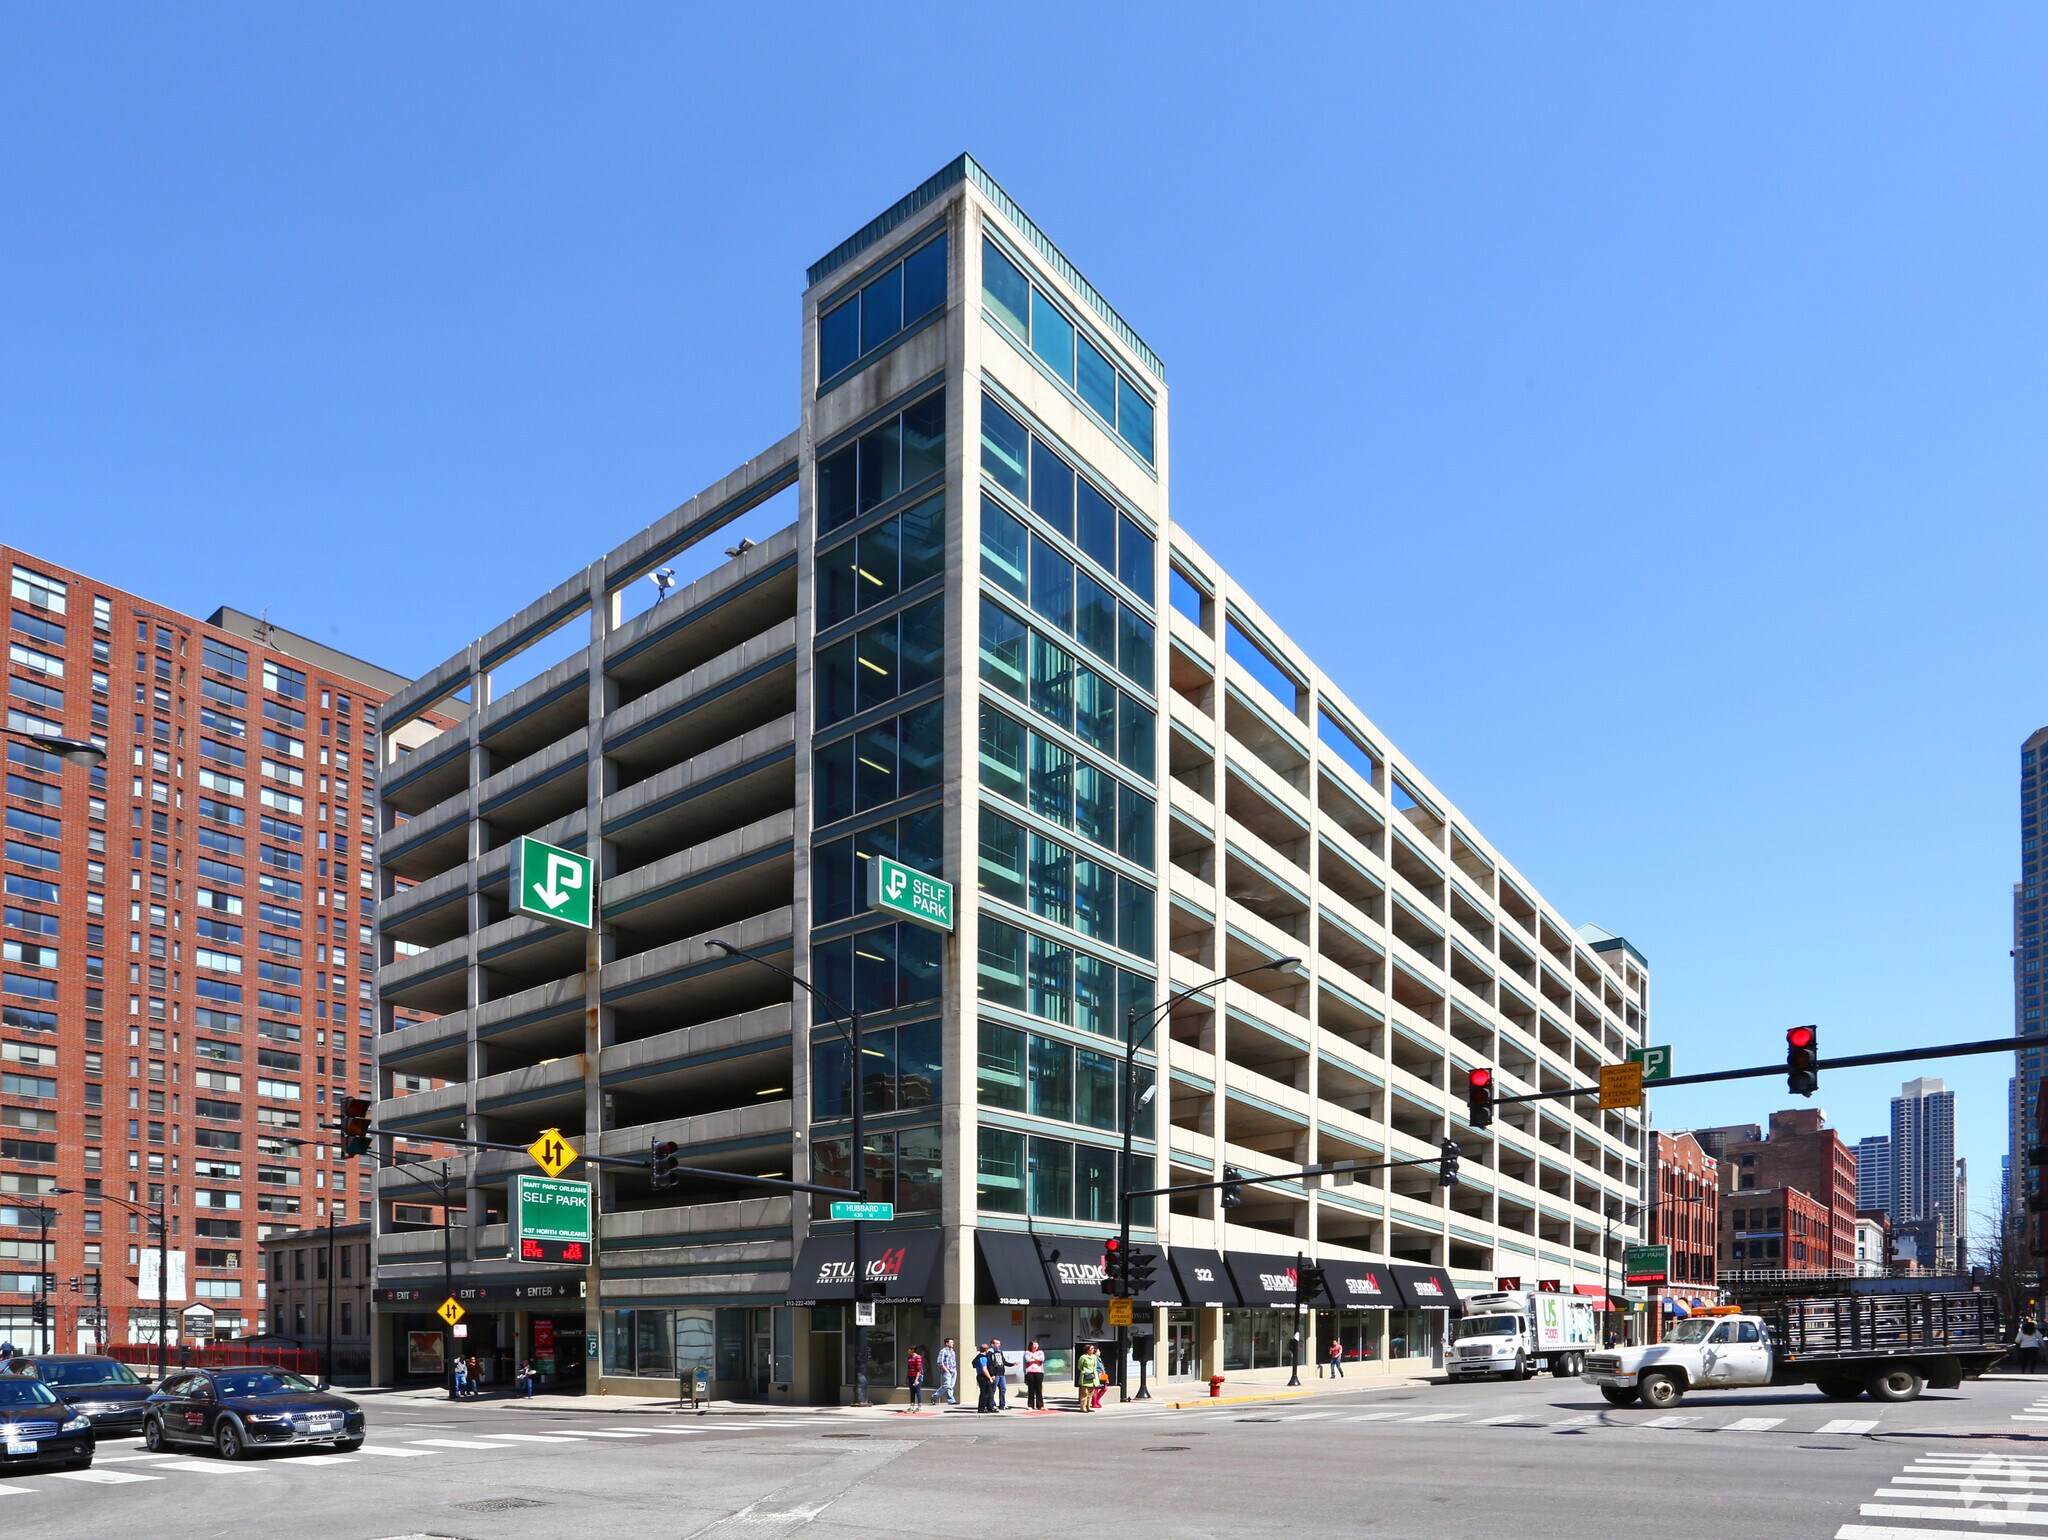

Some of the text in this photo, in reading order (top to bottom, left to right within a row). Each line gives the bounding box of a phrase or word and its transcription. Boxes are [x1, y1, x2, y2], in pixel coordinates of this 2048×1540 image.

[913, 879, 946, 901] SELF
[913, 895, 947, 919] PARK
[1604, 1067, 1638, 1075] ONCOMING
[1607, 1075, 1634, 1083] TRAFFIC
[1603, 1089, 1637, 1097] EXTENDED
[523, 1192, 587, 1207] SELF PARK
[819, 1260, 885, 1277] STUIO
[1194, 1268, 1214, 1282] 322
[1259, 1274, 1294, 1287] STUDIO
[1345, 1279, 1374, 1290] STUDIO
[1414, 1282, 1437, 1292] STUDIO
[397, 1291, 410, 1300] EXIT
[461, 1290, 475, 1299] EXIT
[527, 1287, 552, 1296] ENTER
[1545, 1328, 1559, 1339] FOODS
